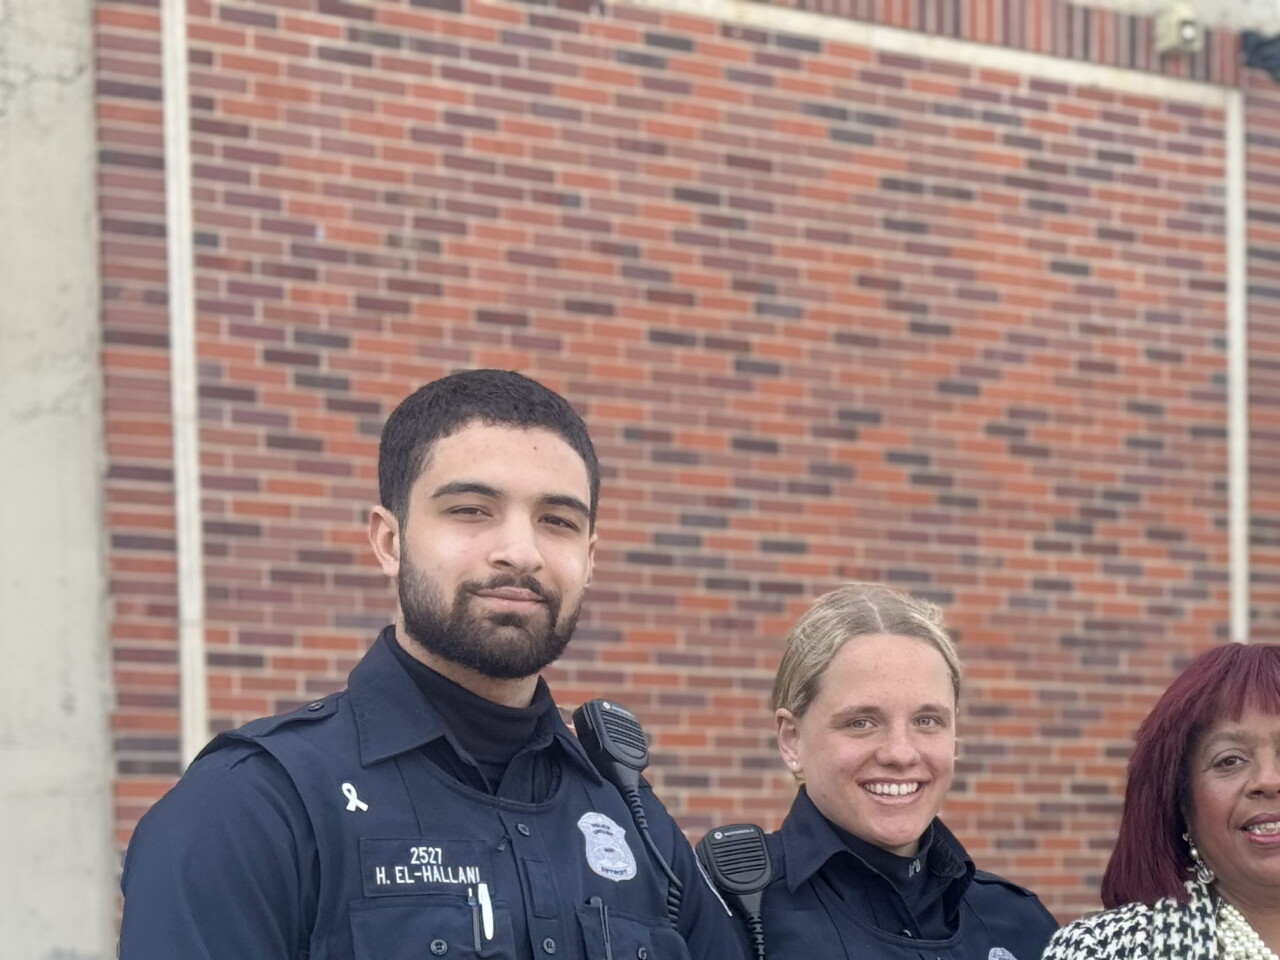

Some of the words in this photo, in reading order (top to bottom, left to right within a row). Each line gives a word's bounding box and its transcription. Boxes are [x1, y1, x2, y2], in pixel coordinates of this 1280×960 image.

[410, 847, 442, 865] 2527
[376, 866, 391, 885] H.
[395, 865, 480, 884] EL-HALLANI
